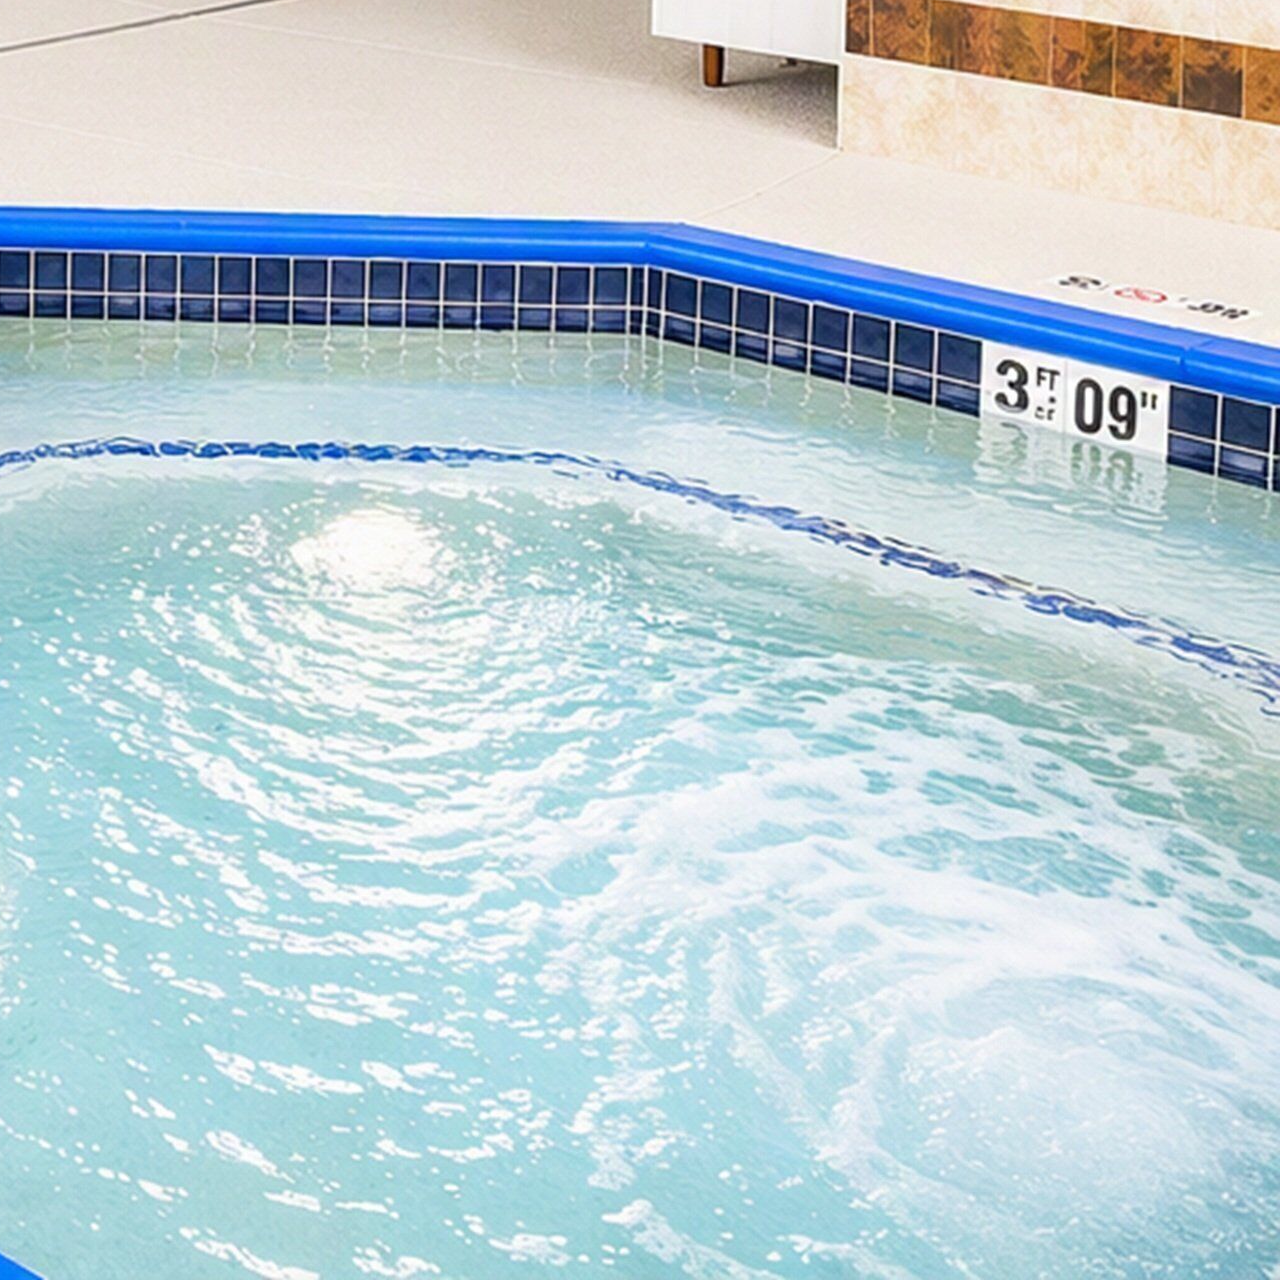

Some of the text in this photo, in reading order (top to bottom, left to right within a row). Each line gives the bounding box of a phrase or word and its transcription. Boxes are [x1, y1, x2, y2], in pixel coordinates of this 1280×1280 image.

[994, 359, 1029, 414] 3
[1036, 367, 1061, 391] FT
[1074, 377, 1159, 441] 09"
